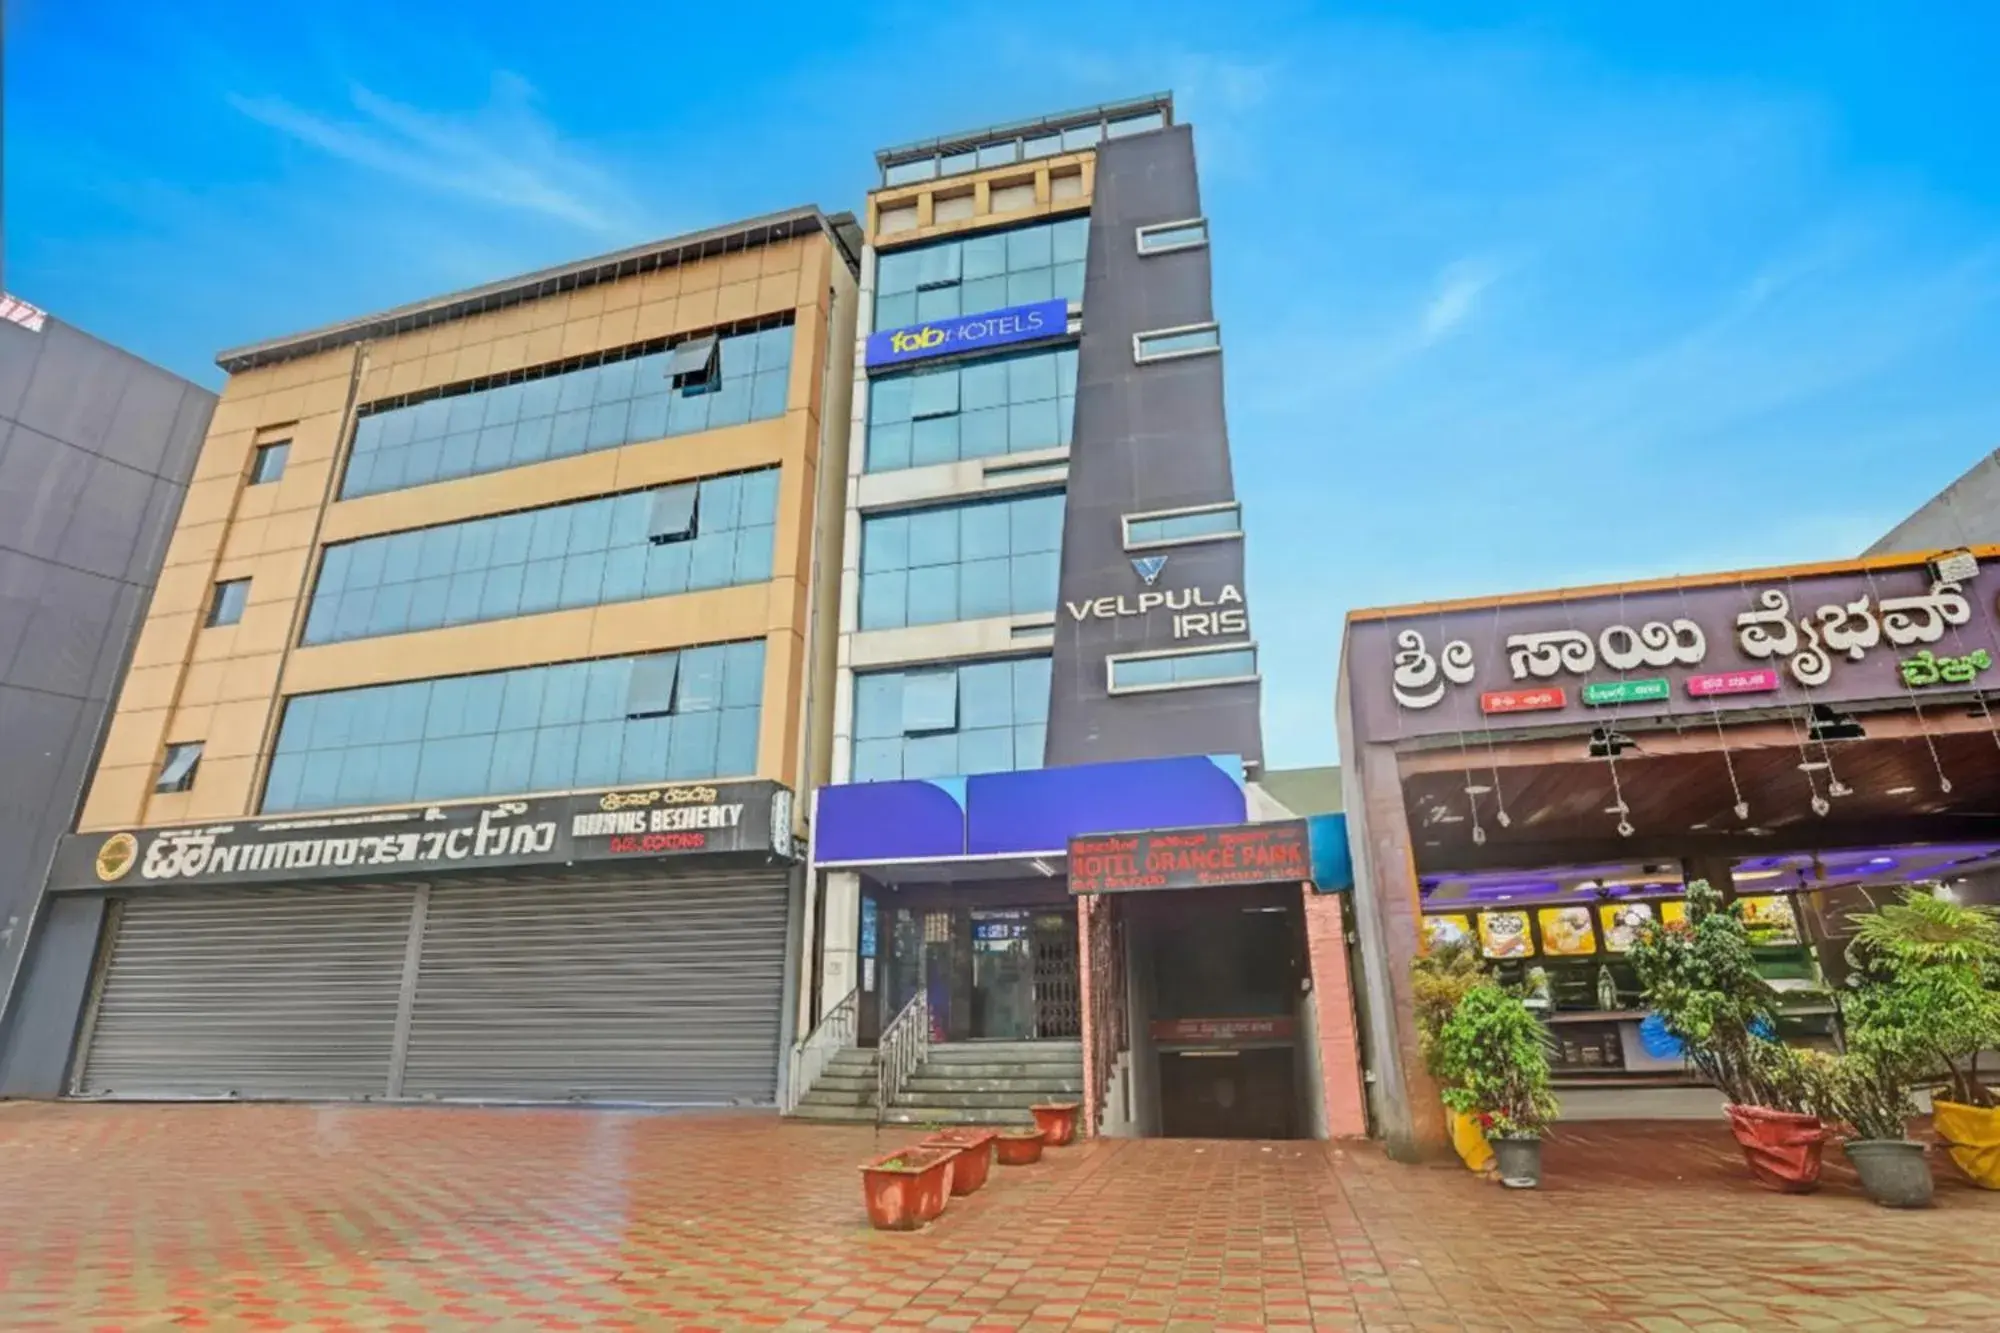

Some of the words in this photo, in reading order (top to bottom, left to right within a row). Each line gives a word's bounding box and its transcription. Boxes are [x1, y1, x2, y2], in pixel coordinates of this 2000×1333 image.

[1066, 584, 1243, 621] VELPULA
[1173, 609, 1247, 639] IRIS
[1392, 629, 1476, 708] ಶ್ರೀ
[1506, 618, 1707, 681] ಸಾಯಿ
[1736, 582, 1971, 687] ವೈಭವ್
